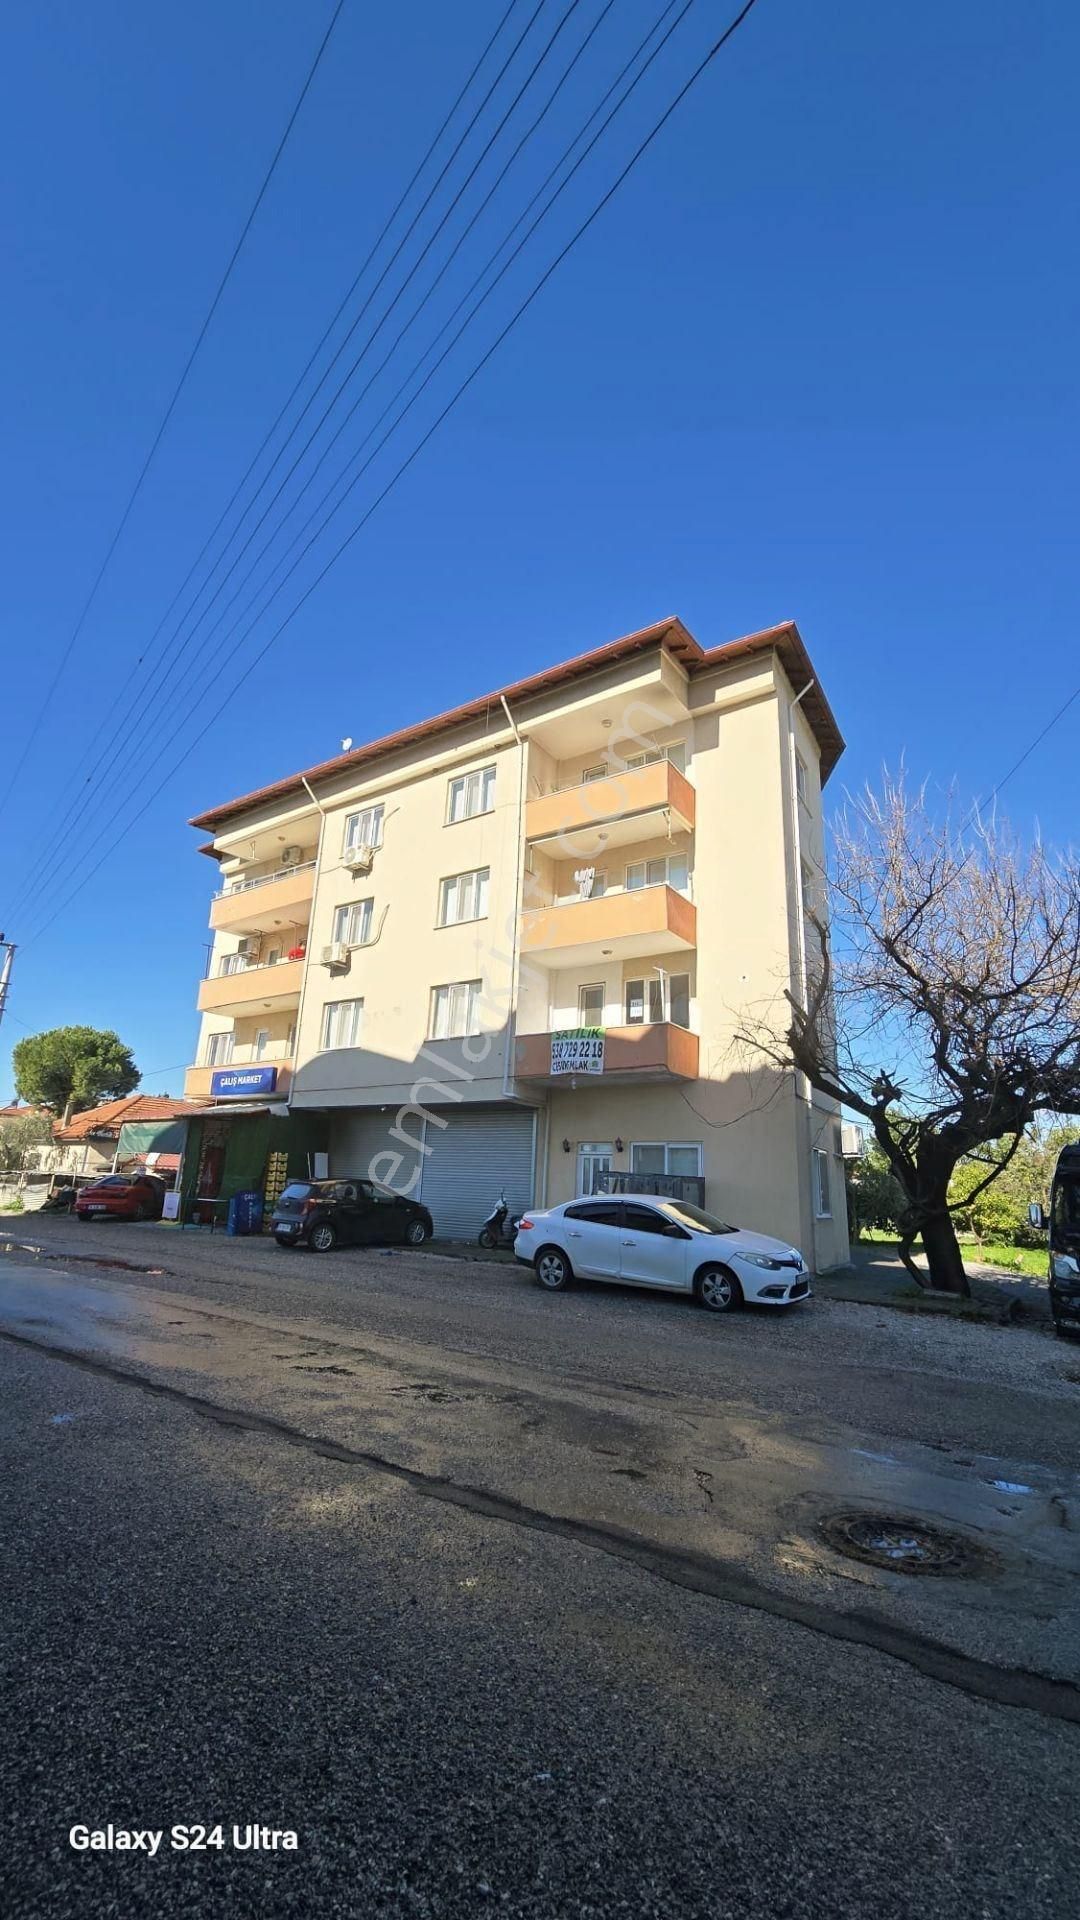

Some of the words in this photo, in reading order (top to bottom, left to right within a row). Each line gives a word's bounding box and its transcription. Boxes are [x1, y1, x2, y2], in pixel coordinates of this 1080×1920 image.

[555, 1028, 600, 1040] SATILIK
[564, 1041, 578, 1058] 729
[579, 1041, 590, 1058] 22
[592, 1041, 603, 1058] 18
[220, 1076, 237, 1088] ÇALIŞ
[238, 1074, 263, 1085] MARKET
